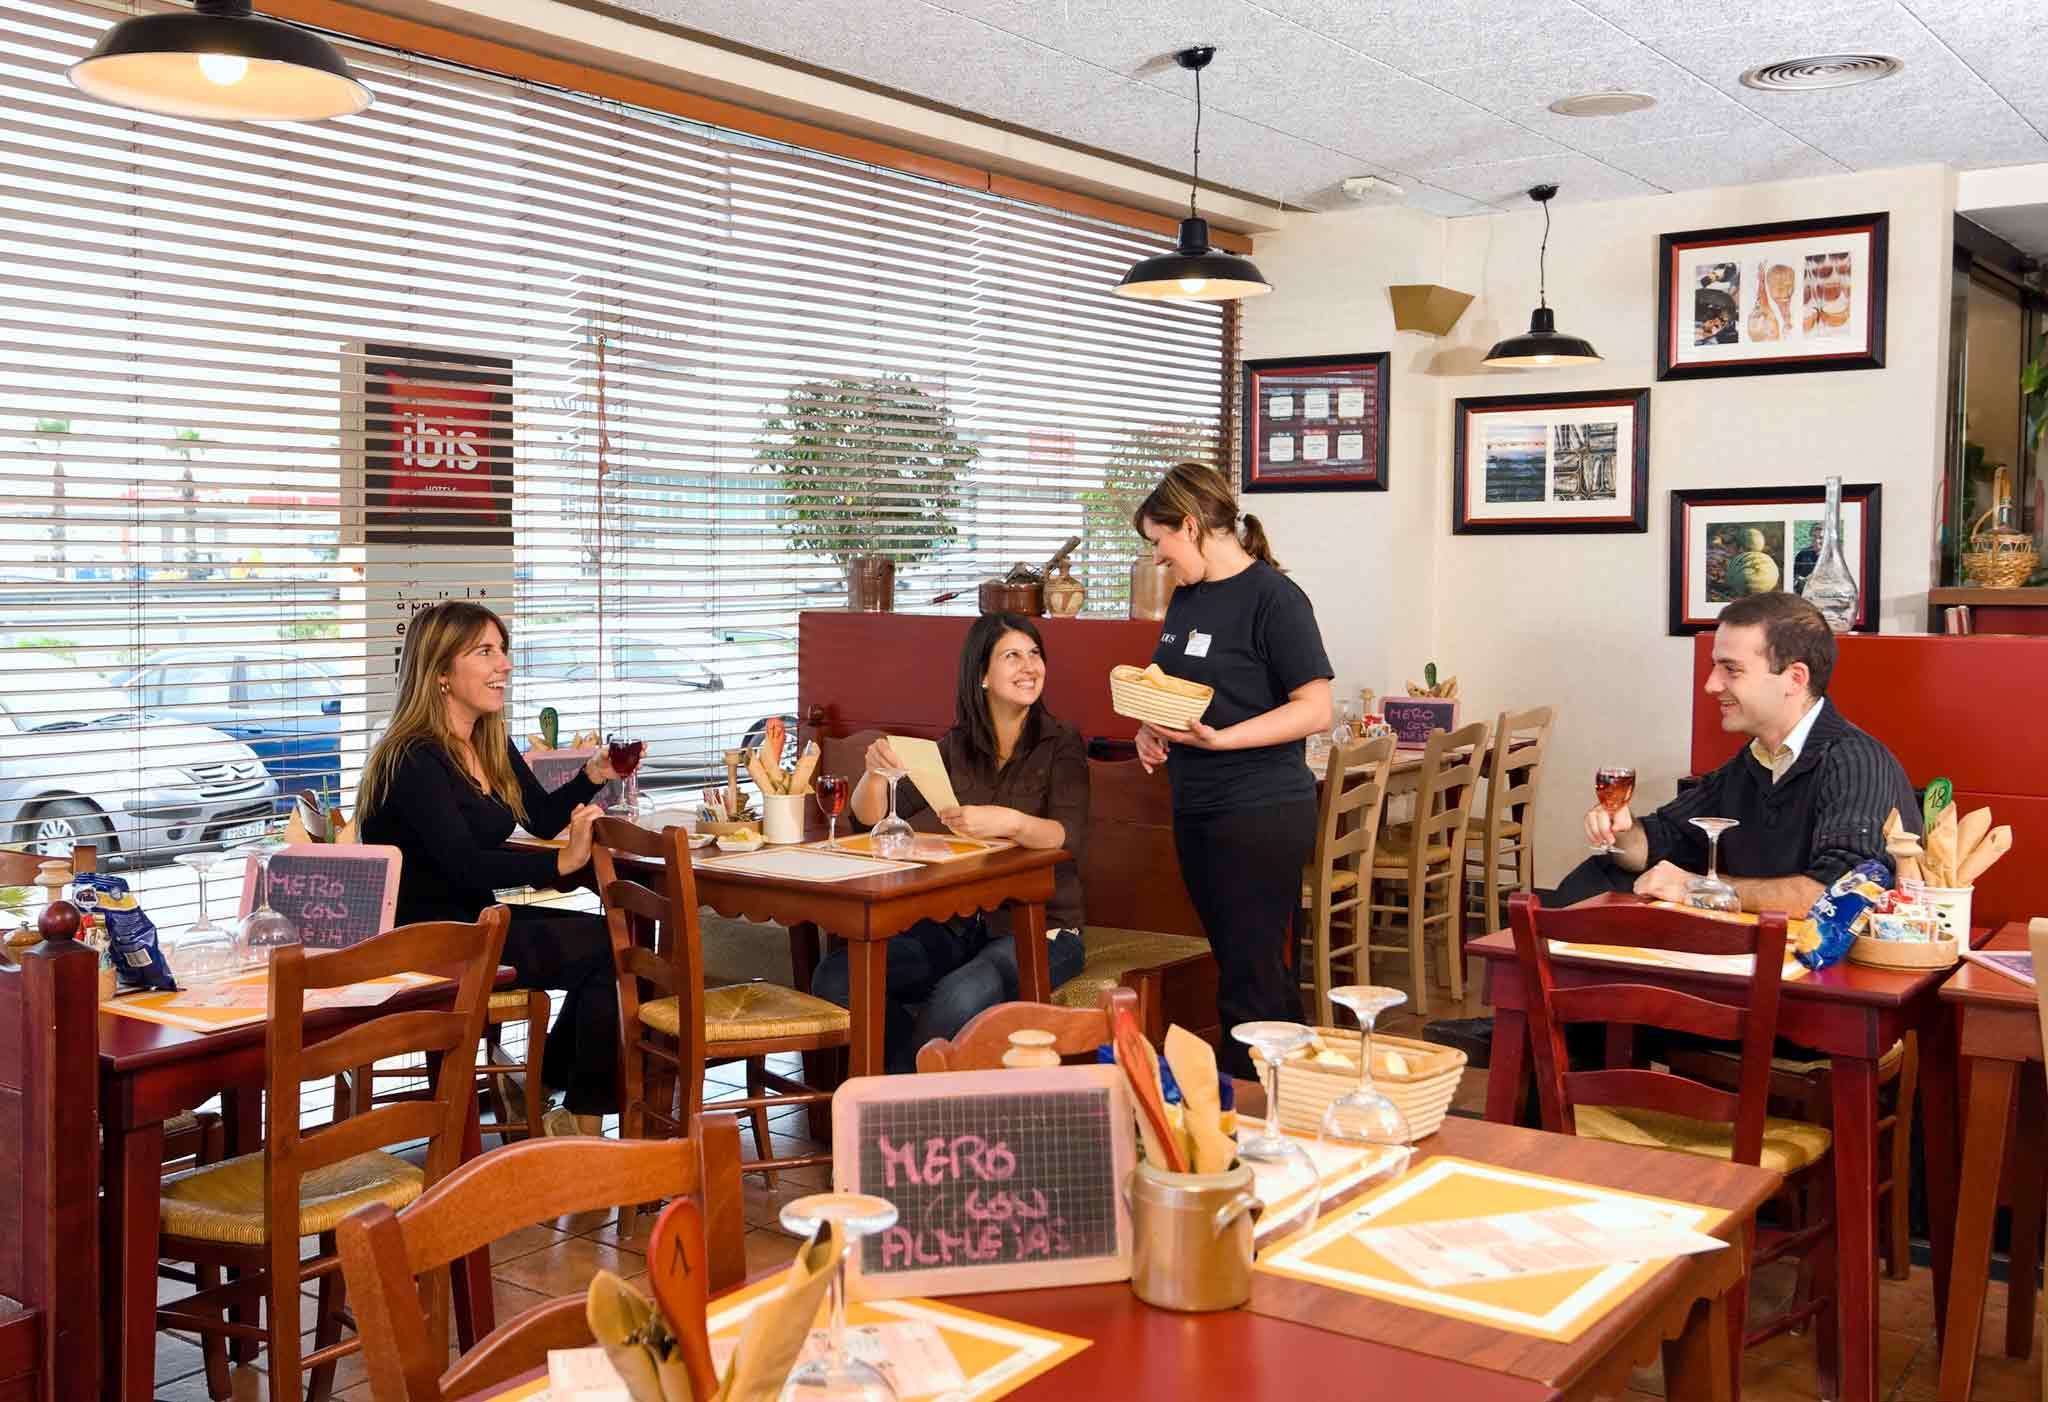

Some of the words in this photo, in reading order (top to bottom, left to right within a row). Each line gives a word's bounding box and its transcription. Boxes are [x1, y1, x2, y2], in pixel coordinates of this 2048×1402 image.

[403, 412, 479, 471] ibis
[269, 871, 345, 898] MERO
[878, 1134, 1017, 1189] MERO
